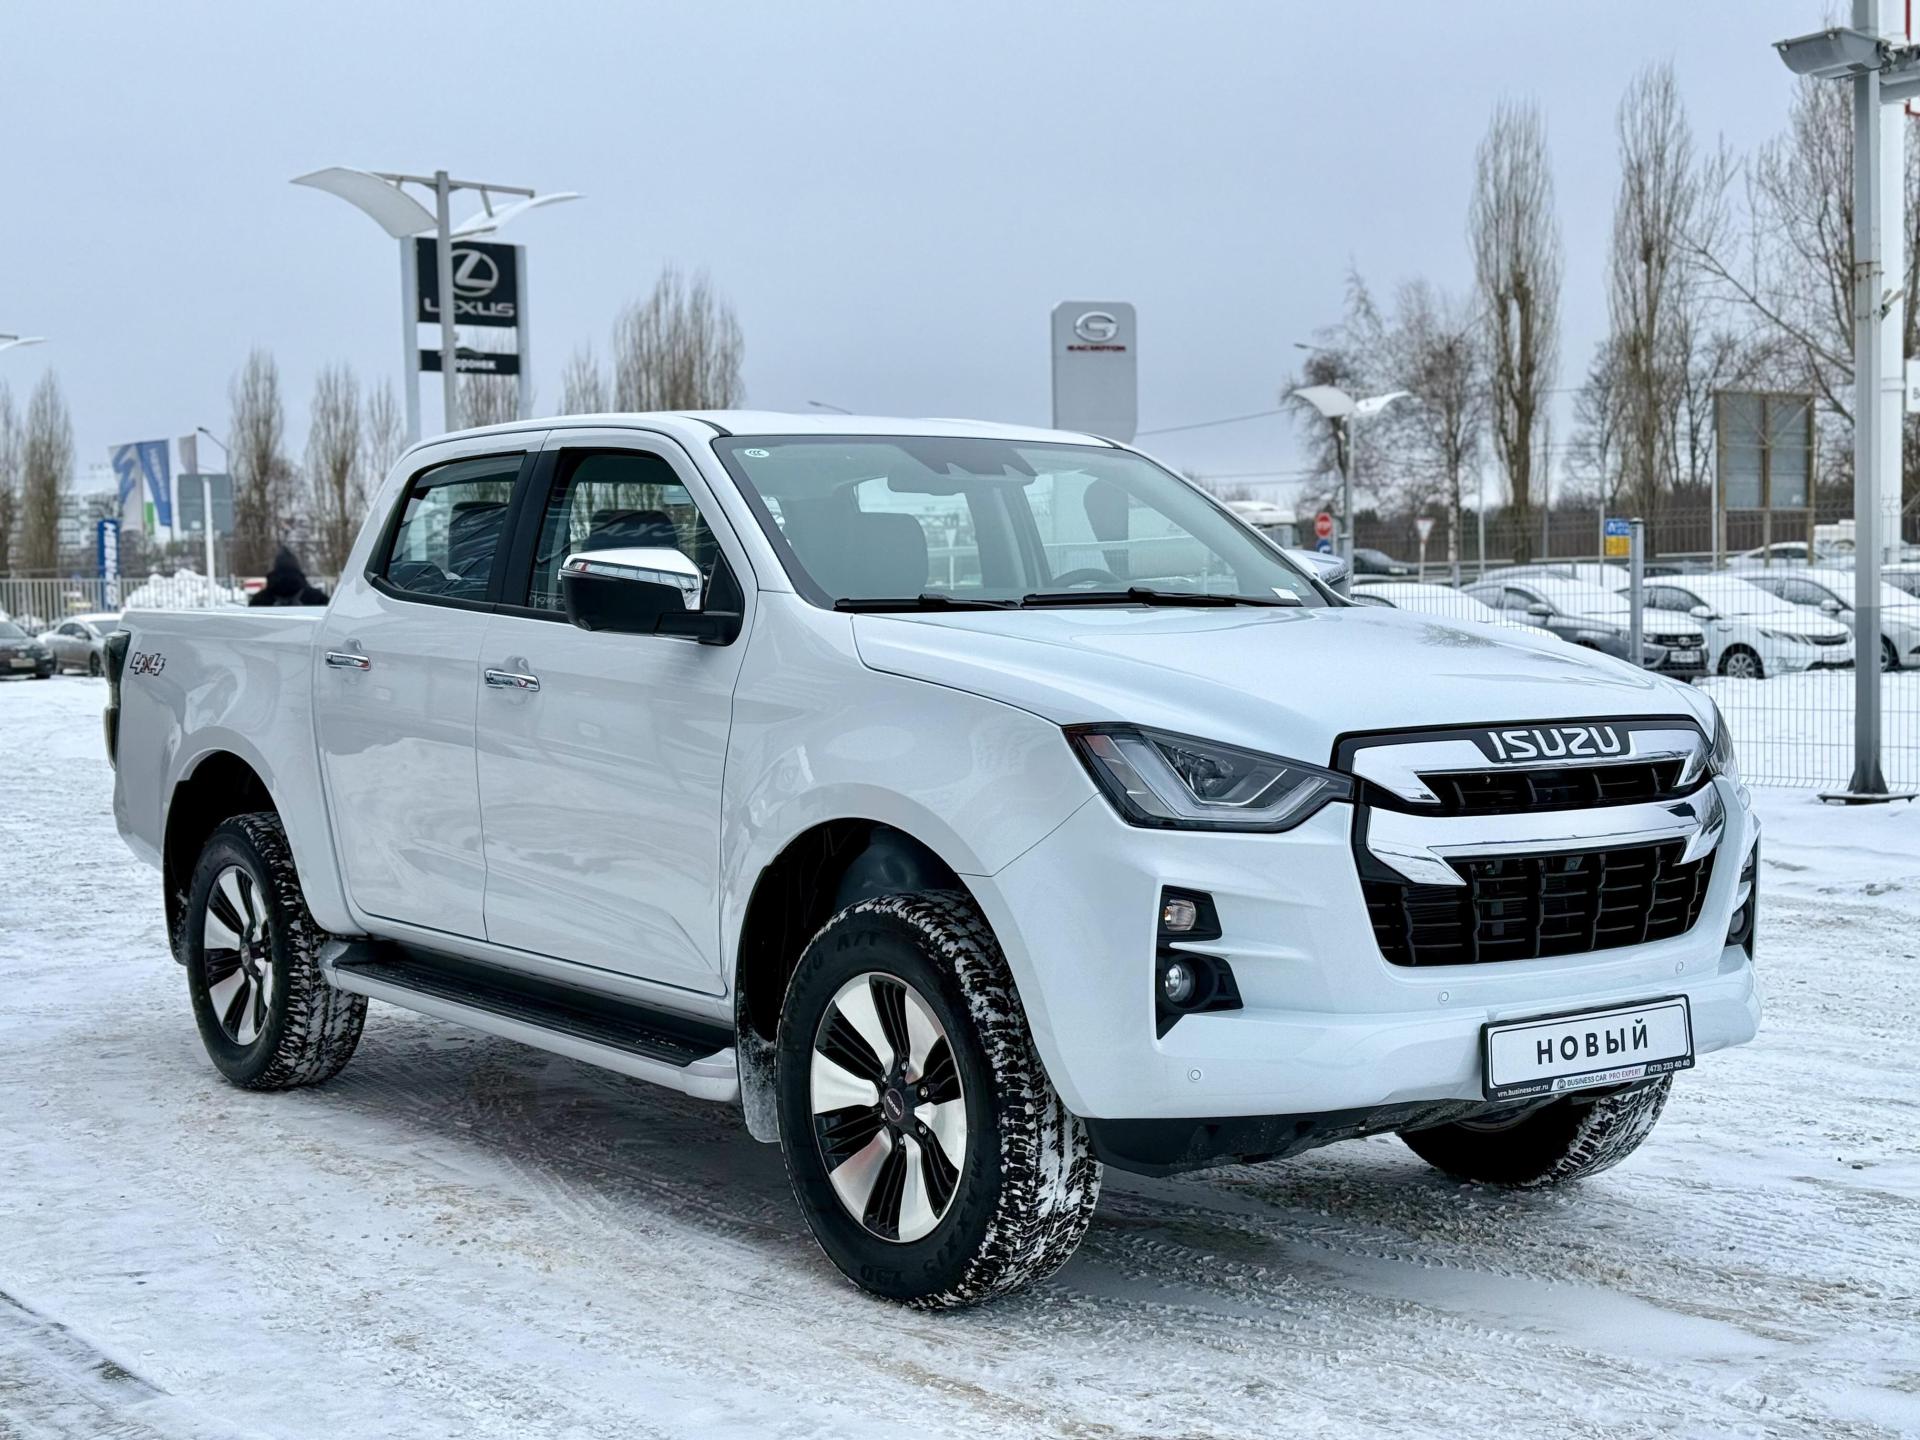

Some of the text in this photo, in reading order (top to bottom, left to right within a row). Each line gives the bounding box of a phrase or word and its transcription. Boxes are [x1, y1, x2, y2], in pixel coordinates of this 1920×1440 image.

[454, 358, 497, 371] оронеж
[1488, 726, 1621, 759] ISUZU
[1536, 1017, 1648, 1065] НОВЫЙ
[1567, 1075, 1595, 1087] BUSINESS
[1595, 1073, 1607, 1082] CAR
[1608, 1071, 1620, 1080] PRO
[1621, 1068, 1641, 1078] EXPERT
